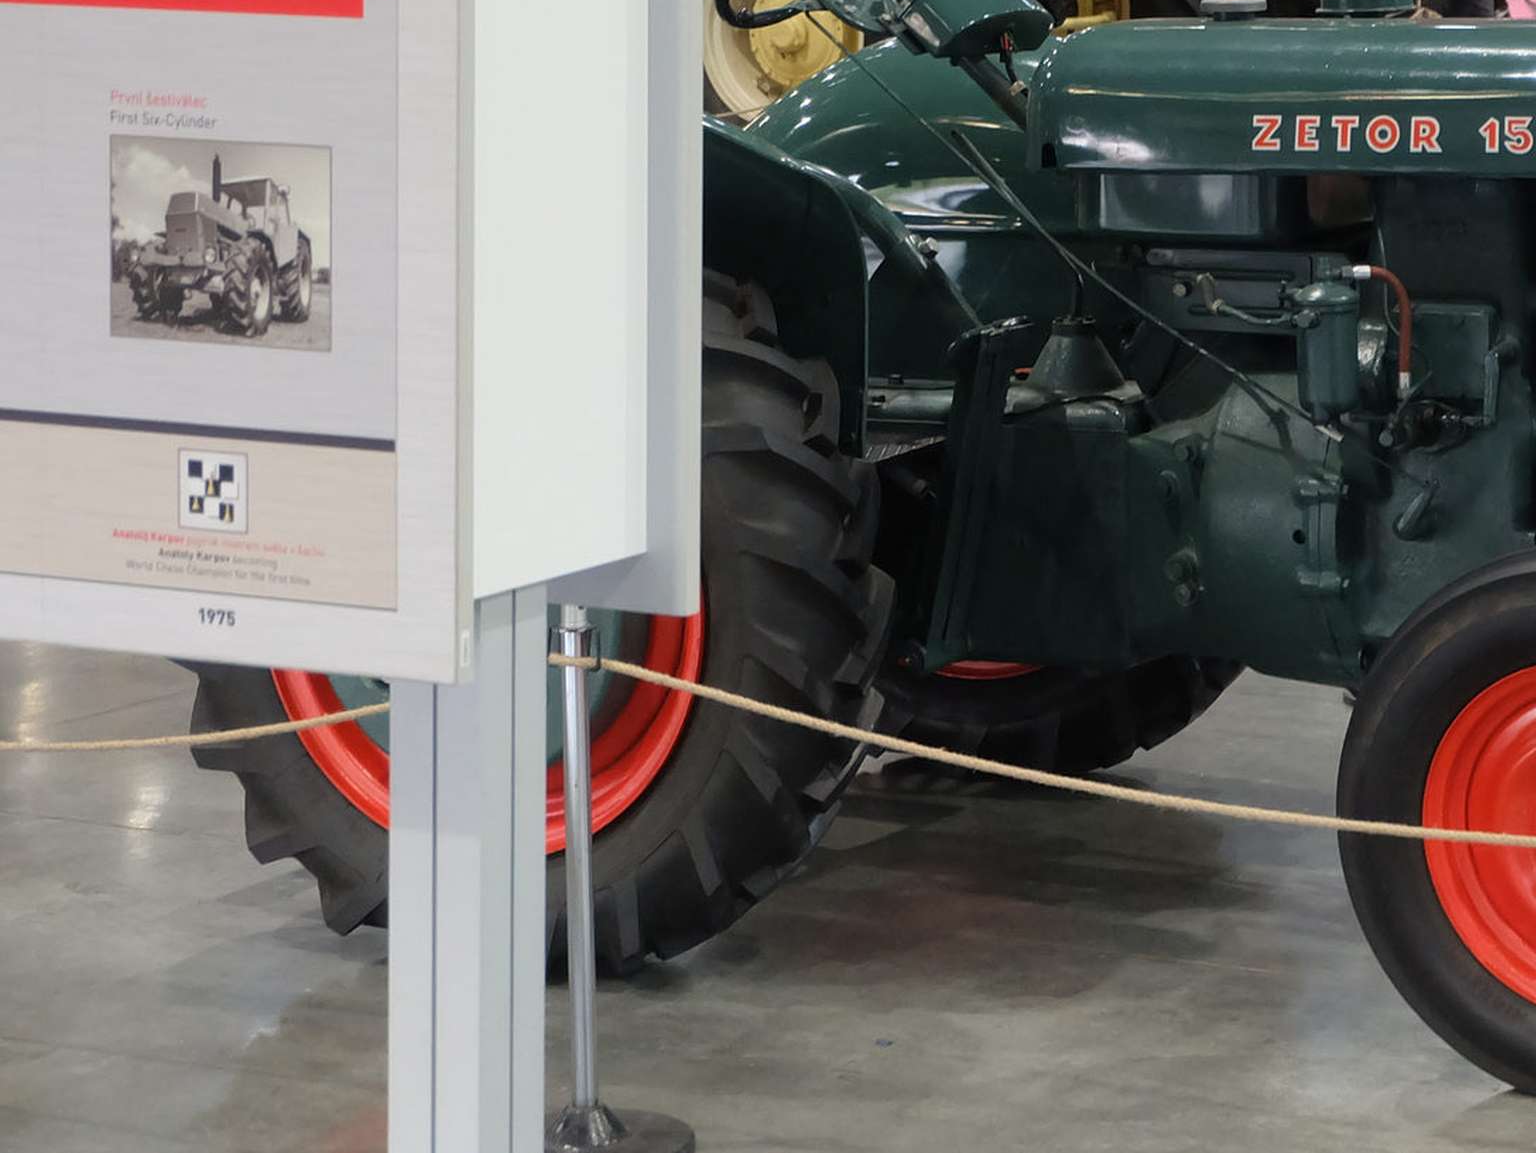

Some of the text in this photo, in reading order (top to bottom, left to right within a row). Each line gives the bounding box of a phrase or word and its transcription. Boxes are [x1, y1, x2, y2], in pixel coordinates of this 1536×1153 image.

[110, 110, 138, 125] First
[1251, 114, 1535, 155] ZETOR 15
[198, 606, 237, 627] 1975
